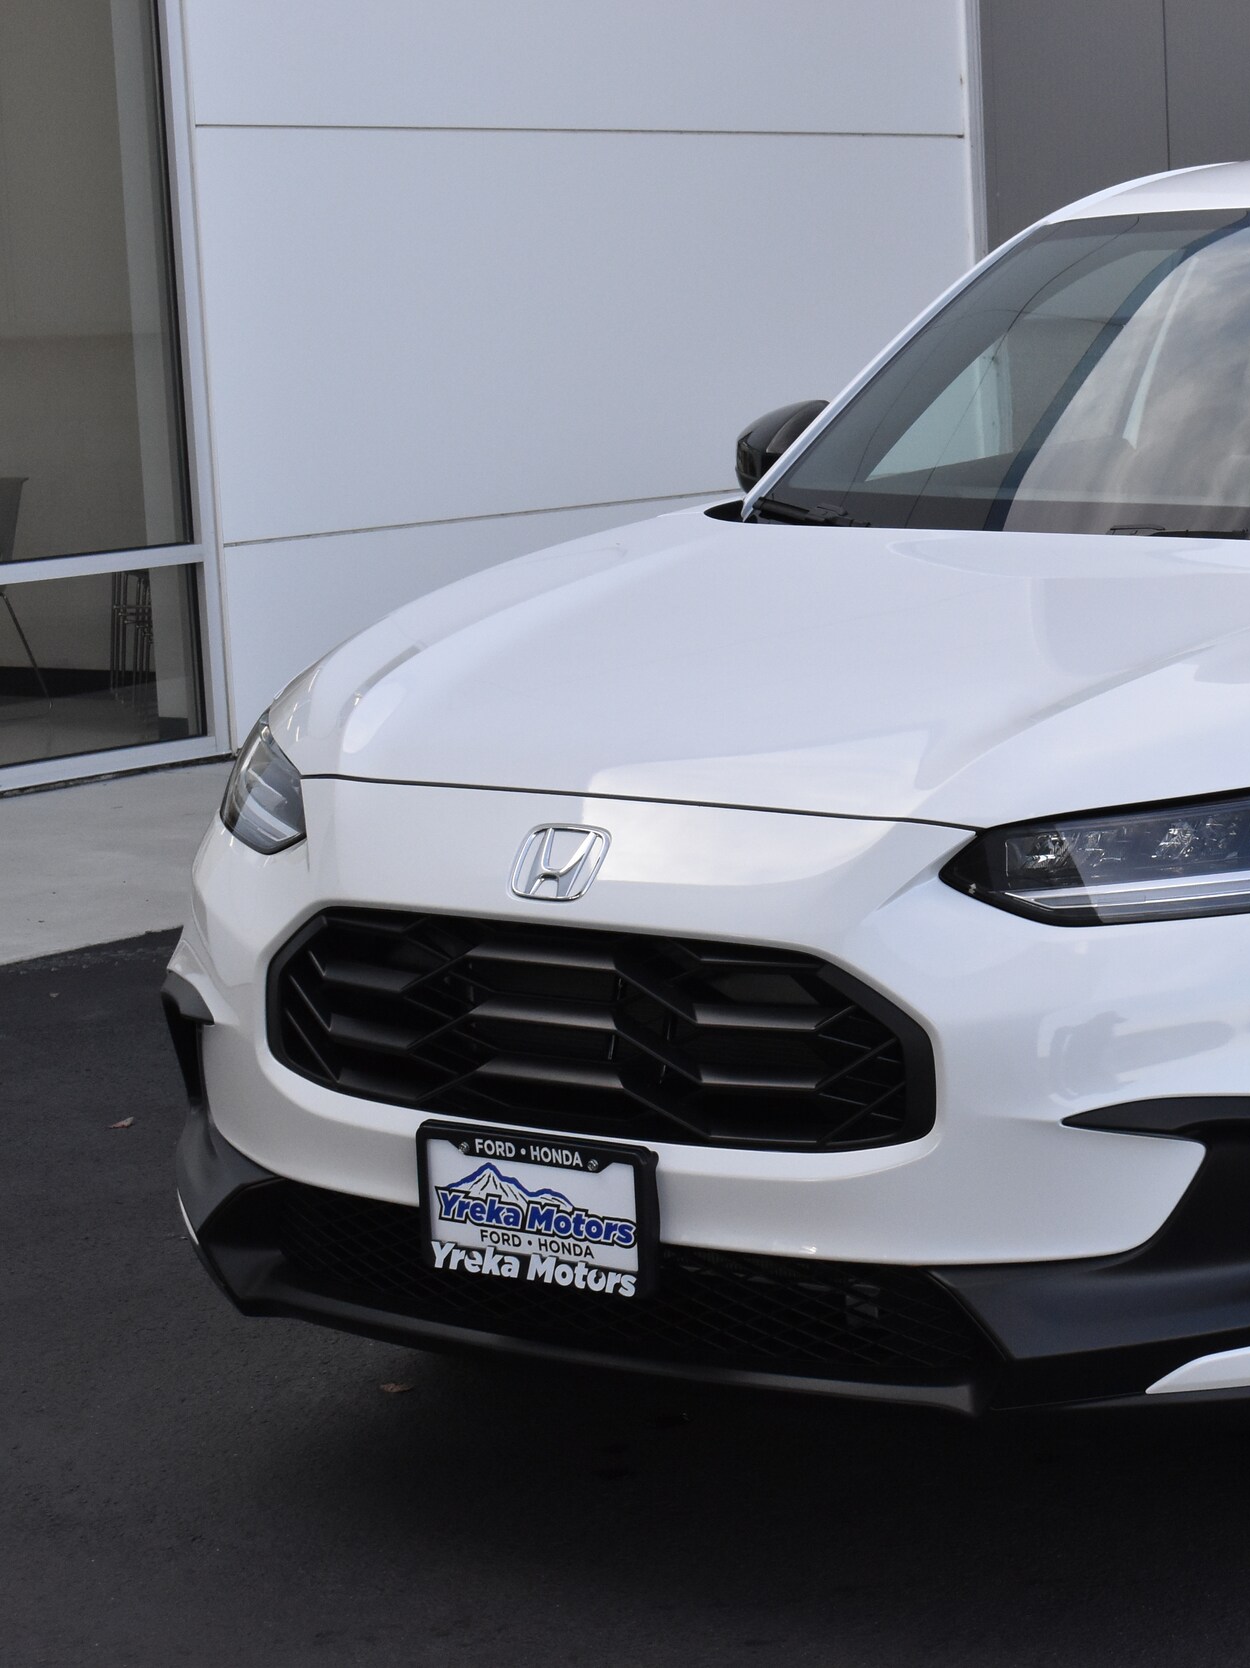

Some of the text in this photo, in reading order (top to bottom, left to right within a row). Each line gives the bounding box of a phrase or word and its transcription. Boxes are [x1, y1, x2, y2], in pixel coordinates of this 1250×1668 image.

[475, 1139, 583, 1167] FORD HONDA
[438, 1189, 636, 1246] Yreka Motors
[480, 1229, 594, 1259] FORD HONDA
[431, 1241, 637, 1297] Yreka Motors
